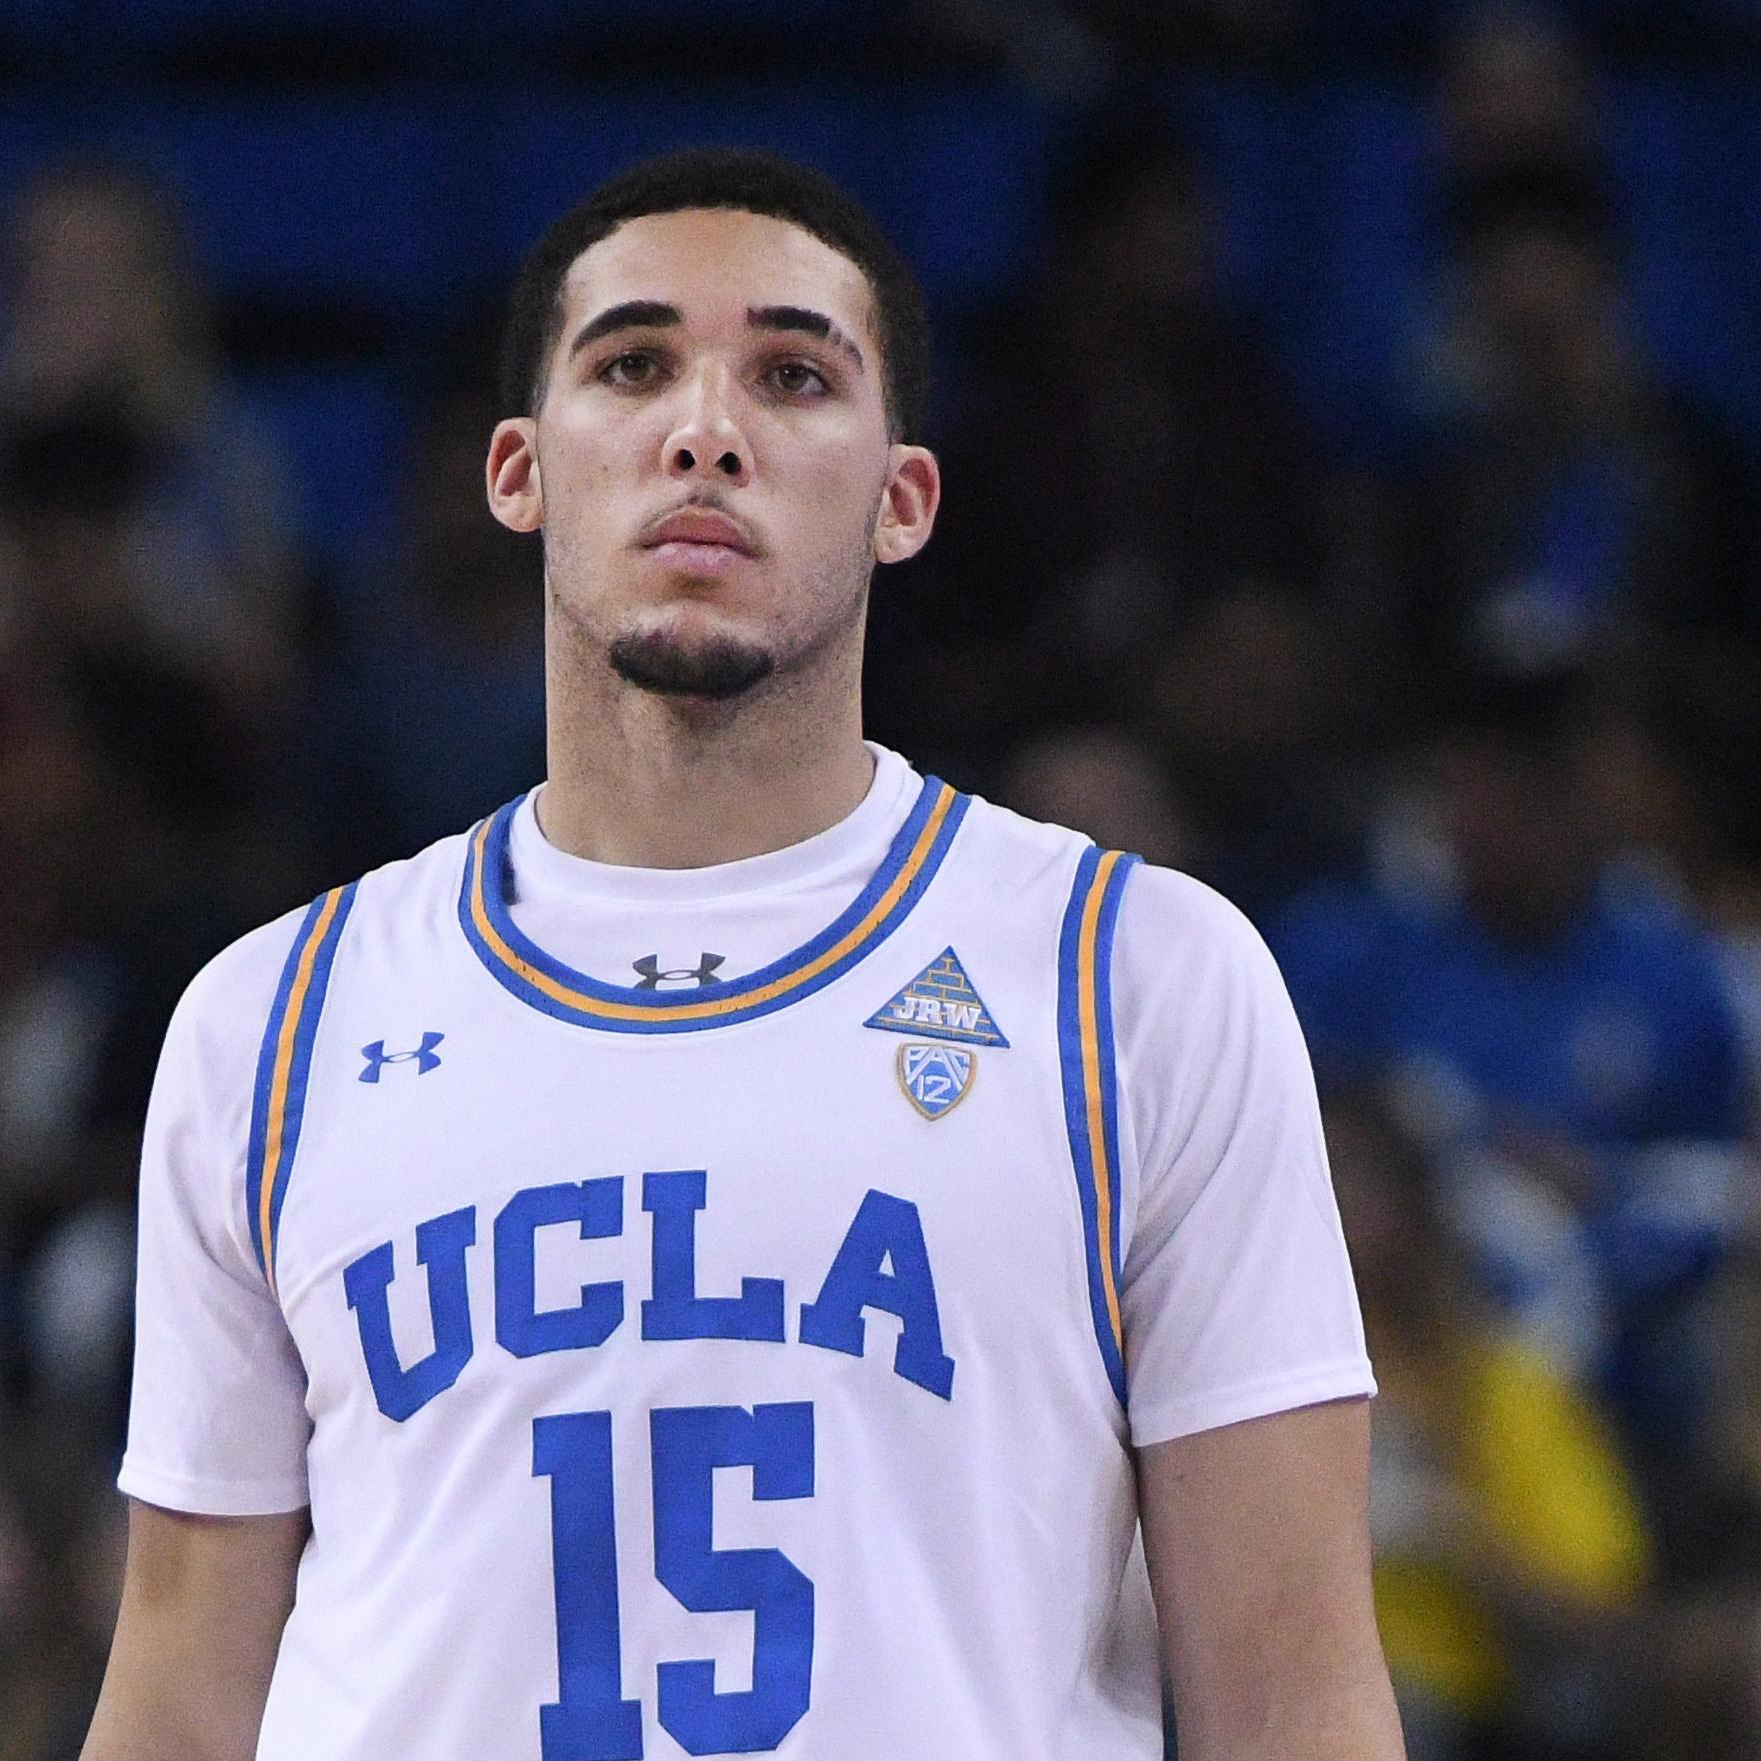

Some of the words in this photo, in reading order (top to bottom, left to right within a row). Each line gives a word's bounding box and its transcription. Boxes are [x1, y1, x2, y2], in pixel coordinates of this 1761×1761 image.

[894, 996, 982, 1030] JRW
[904, 1046, 972, 1092] PAC
[916, 1074, 952, 1104] 12
[343, 1170, 955, 1423] UCLA
